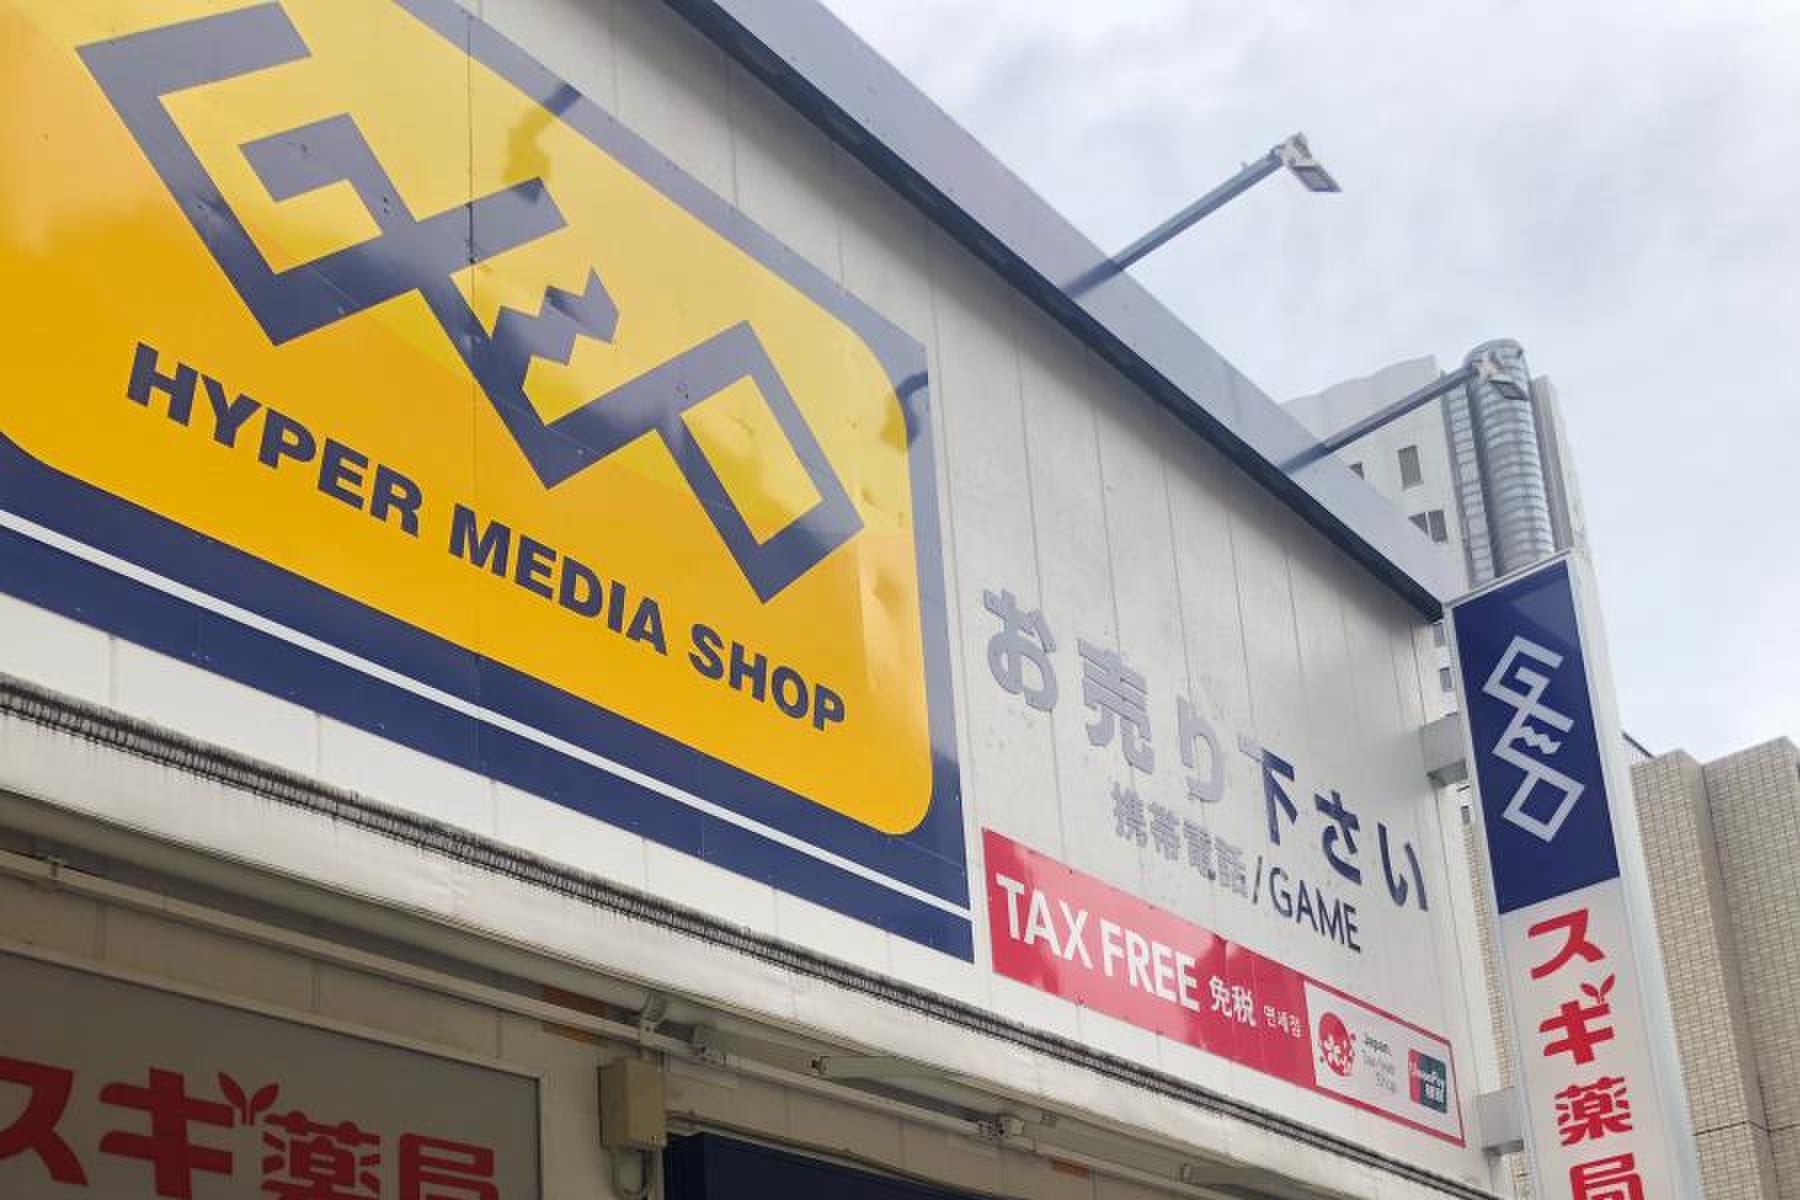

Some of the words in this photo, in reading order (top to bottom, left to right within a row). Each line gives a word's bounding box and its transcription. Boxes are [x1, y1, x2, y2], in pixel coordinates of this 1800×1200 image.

[126, 341, 423, 537] HYPER
[449, 502, 668, 655] MEDIA
[689, 622, 847, 732] SHOP
[983, 588, 1429, 912] お売り下さい
[996, 874, 1093, 970] TAX
[1099, 918, 1200, 1012] FREE
[1209, 975, 1256, 1027] 免税
